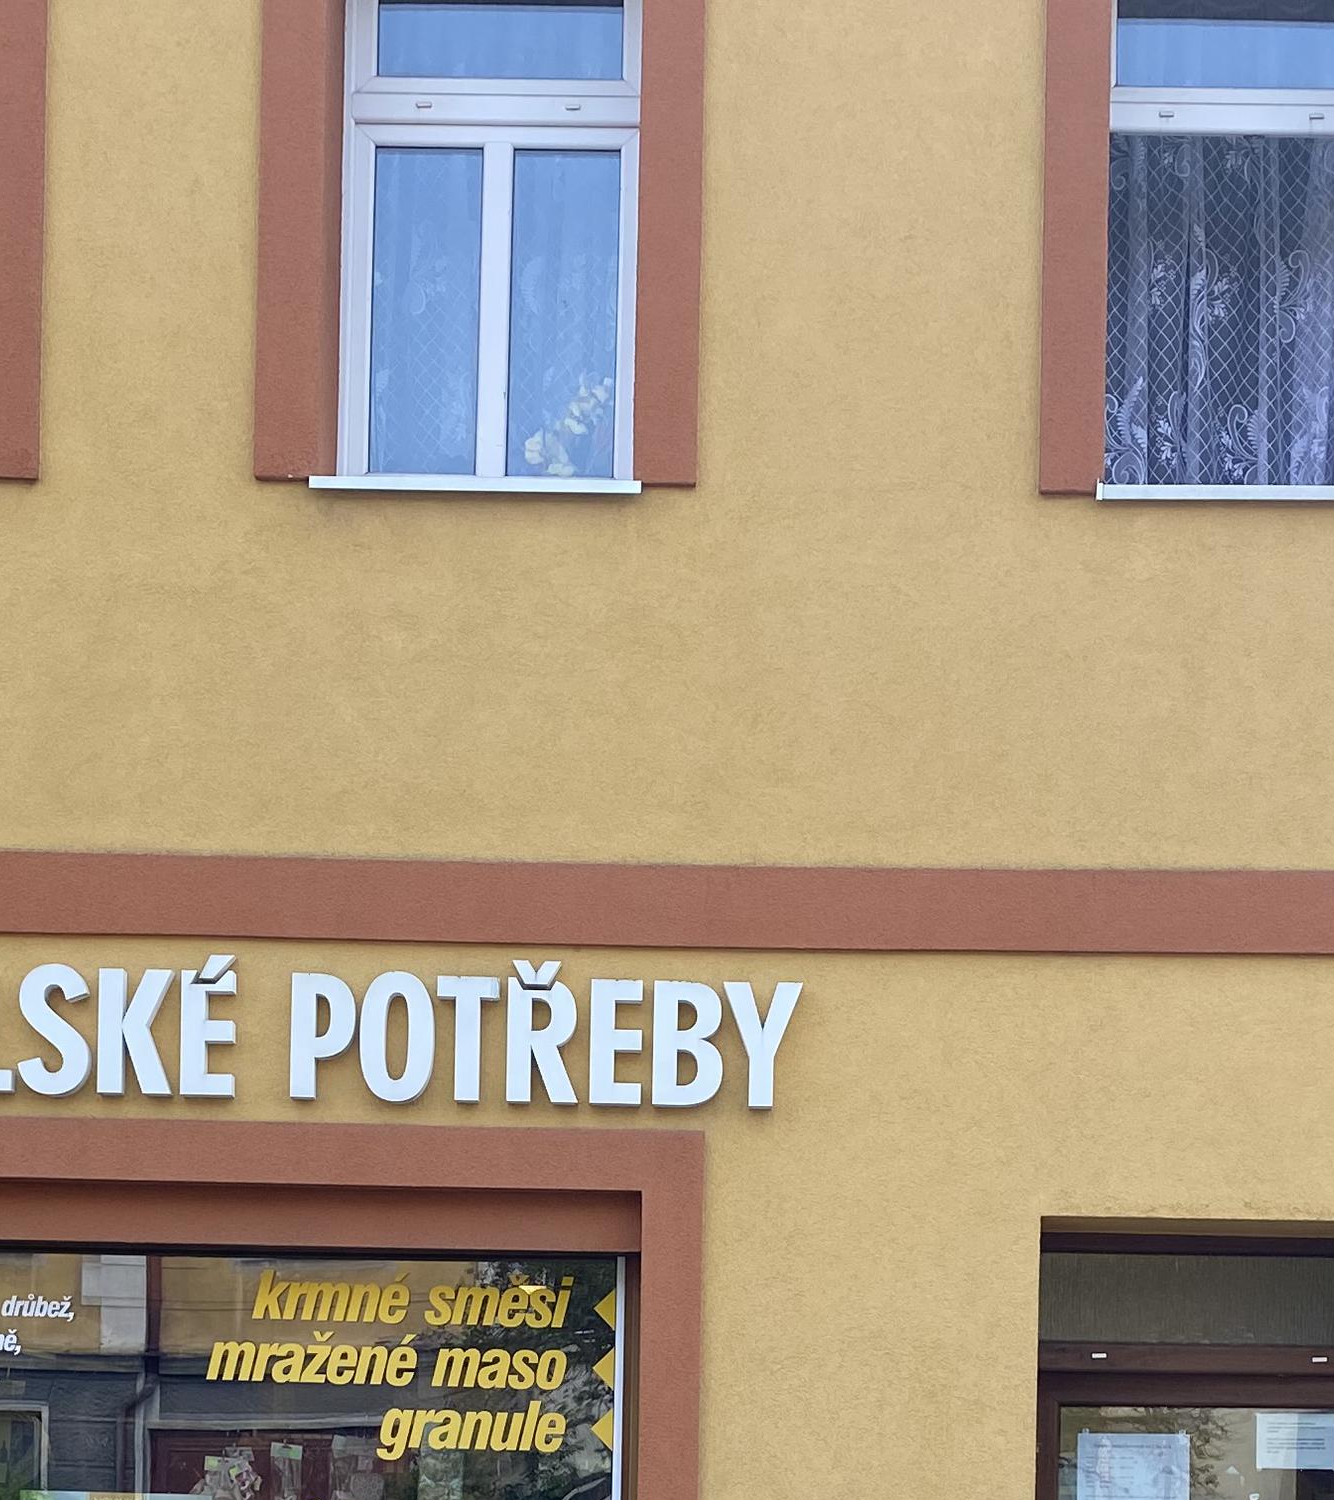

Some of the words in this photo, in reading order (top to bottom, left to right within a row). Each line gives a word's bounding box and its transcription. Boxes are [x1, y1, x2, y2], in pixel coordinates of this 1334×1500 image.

[288, 957, 803, 1112] POTŘEBY
[1, 1294, 75, 1322] drůbež,
[252, 1269, 411, 1324] krmné
[424, 1274, 574, 1329] směsi
[205, 1331, 418, 1386] mražené
[430, 1346, 568, 1391] maso
[376, 1400, 566, 1461] granule
